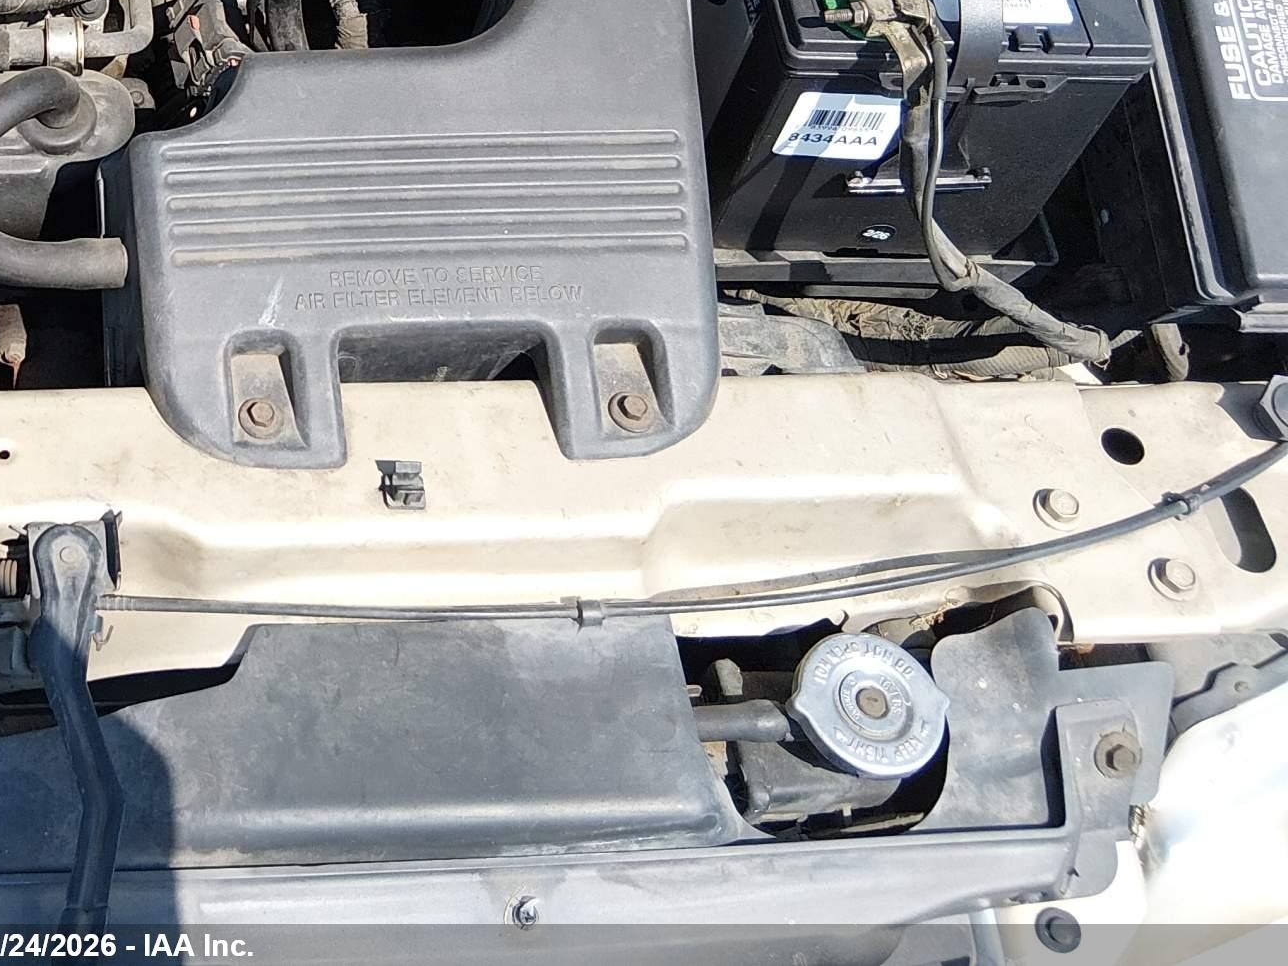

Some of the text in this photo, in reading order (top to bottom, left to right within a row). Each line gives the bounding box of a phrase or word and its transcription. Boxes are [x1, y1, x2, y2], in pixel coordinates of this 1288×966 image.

[1211, 0, 1231, 17] &
[1214, 25, 1251, 99] FUSE
[1257, 23, 1284, 82] DAMAGE
[788, 132, 877, 146] 8434AAA
[329, 265, 544, 287] REMOVE TO SERVICE
[295, 285, 583, 312] AIR FILTER ELEMENT BELOW
